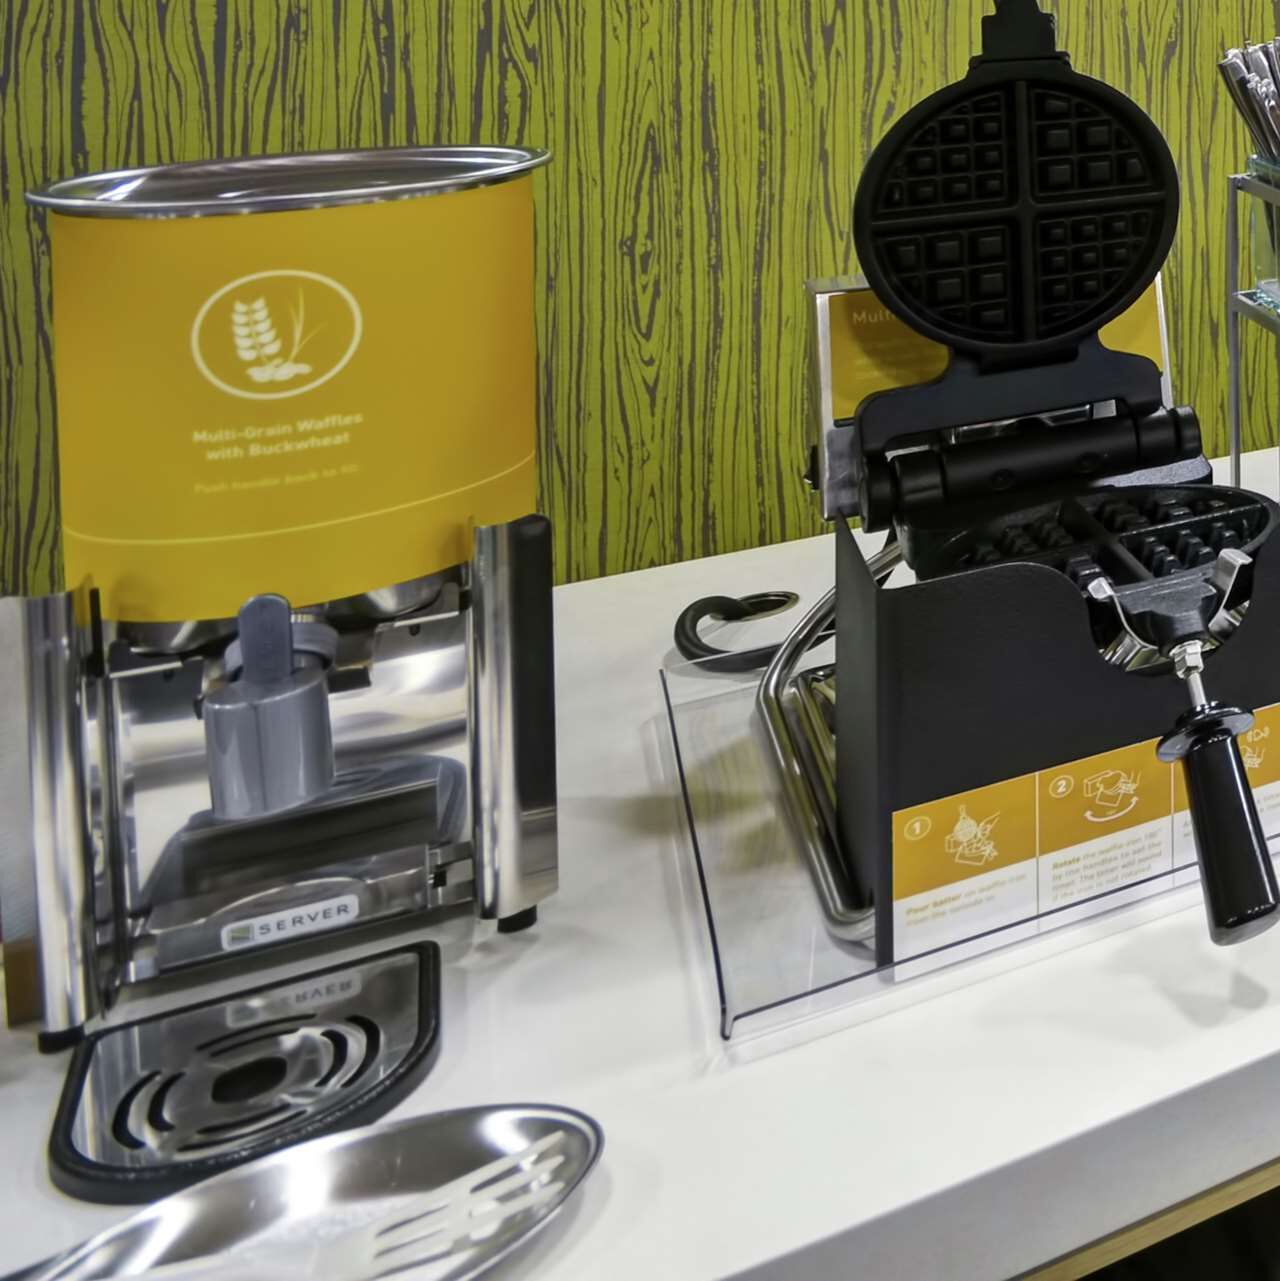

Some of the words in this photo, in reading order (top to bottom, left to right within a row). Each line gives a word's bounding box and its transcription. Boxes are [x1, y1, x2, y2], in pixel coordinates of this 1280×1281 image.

[191, 423, 294, 444] Multi-Grain
[296, 412, 364, 433] Waffles
[206, 445, 244, 462] with
[248, 431, 350, 457] Buckwheat
[1056, 780, 1067, 794] 2
[912, 821, 921, 835] 1
[258, 903, 350, 936] SERVER
